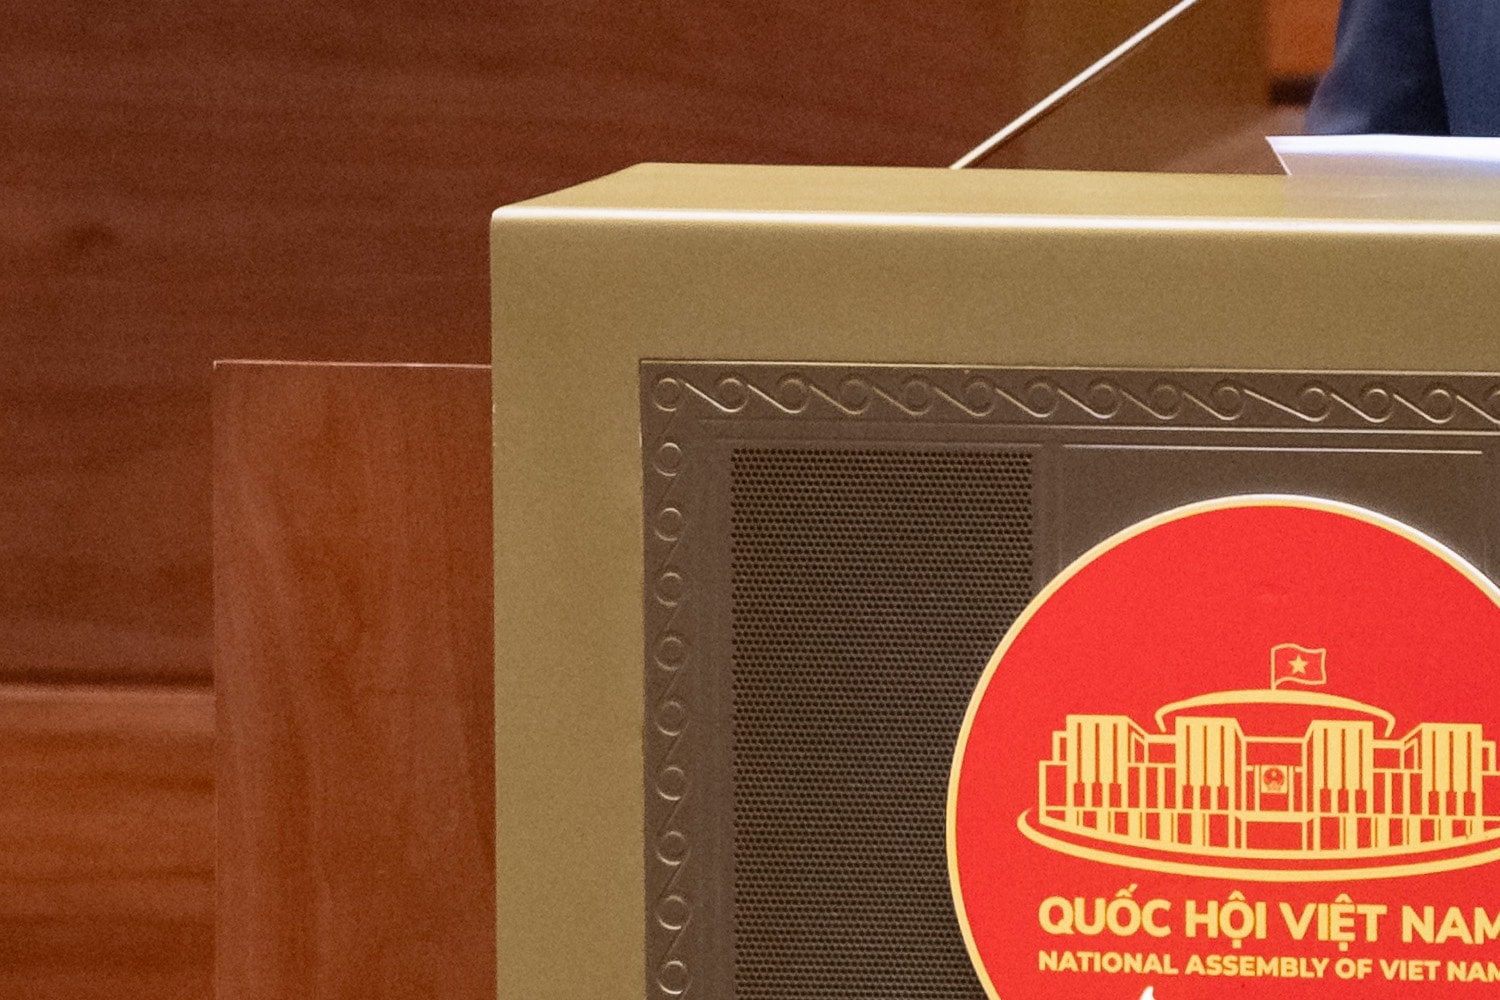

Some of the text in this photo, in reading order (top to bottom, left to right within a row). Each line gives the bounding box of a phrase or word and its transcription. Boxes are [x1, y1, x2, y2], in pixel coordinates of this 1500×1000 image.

[1038, 883, 1171, 938] QUỐC
[1185, 890, 1267, 949] HỘI
[1279, 893, 1388, 952] VIỆT
[1038, 950, 1179, 975] NATIONAL
[1185, 954, 1329, 979] ASSEMBLY
[1335, 958, 1373, 980] OF
[1379, 959, 1441, 981] VIET
